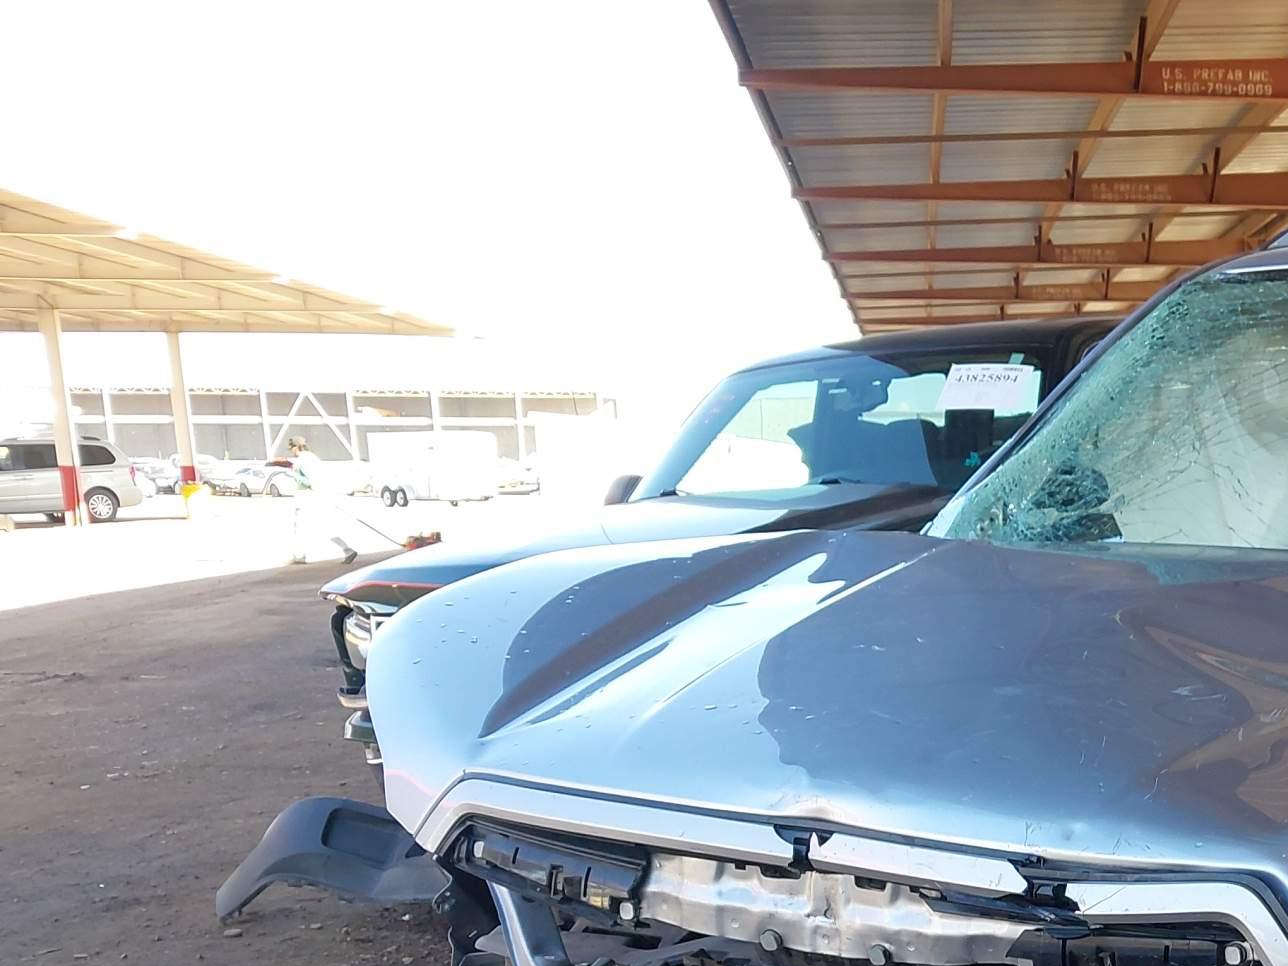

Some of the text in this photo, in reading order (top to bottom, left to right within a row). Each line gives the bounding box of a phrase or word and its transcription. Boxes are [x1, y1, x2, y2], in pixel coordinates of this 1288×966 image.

[1162, 67, 1273, 83] U.S. PREFAB INC.
[954, 373, 1018, 384] 43825894
